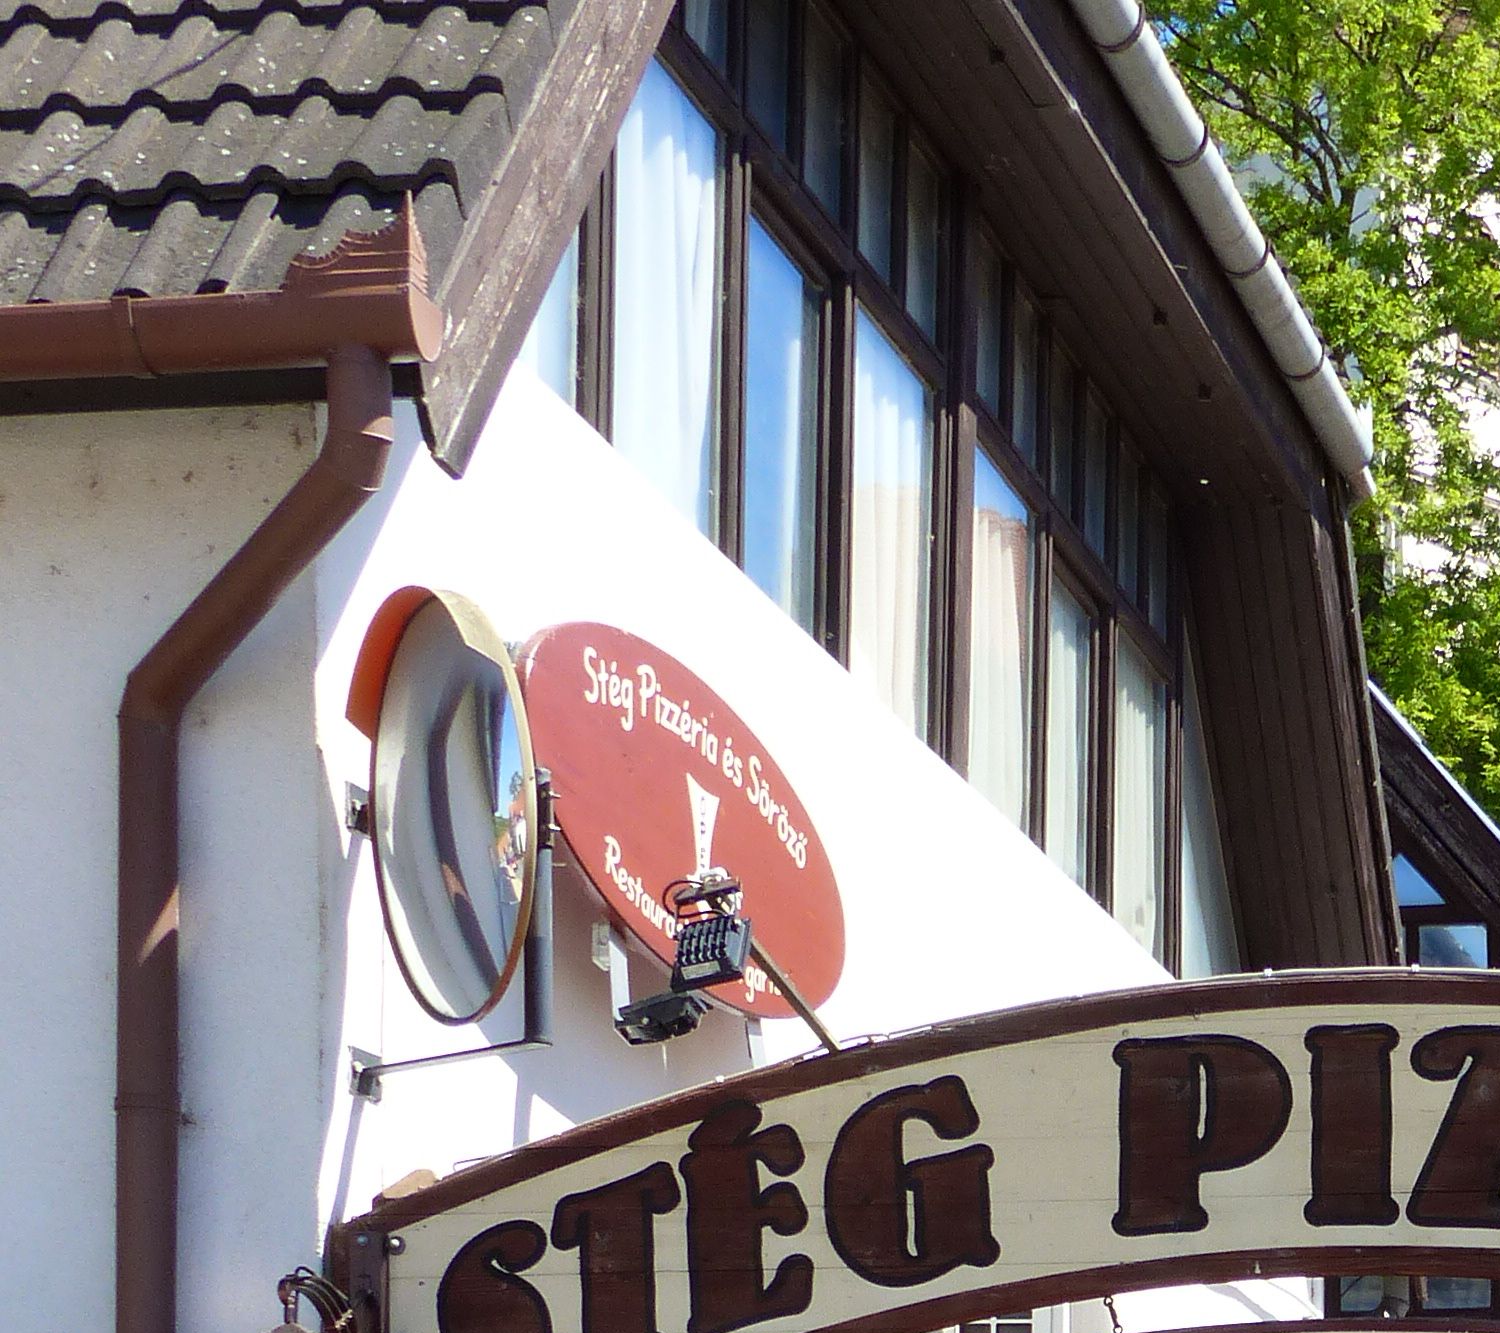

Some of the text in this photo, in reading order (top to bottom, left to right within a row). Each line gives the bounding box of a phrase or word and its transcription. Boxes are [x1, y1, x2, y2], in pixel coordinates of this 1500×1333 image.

[584, 647, 634, 732] Stég
[637, 664, 717, 766] Pizzéria
[723, 737, 744, 788] és
[604, 835, 684, 939] Restaura
